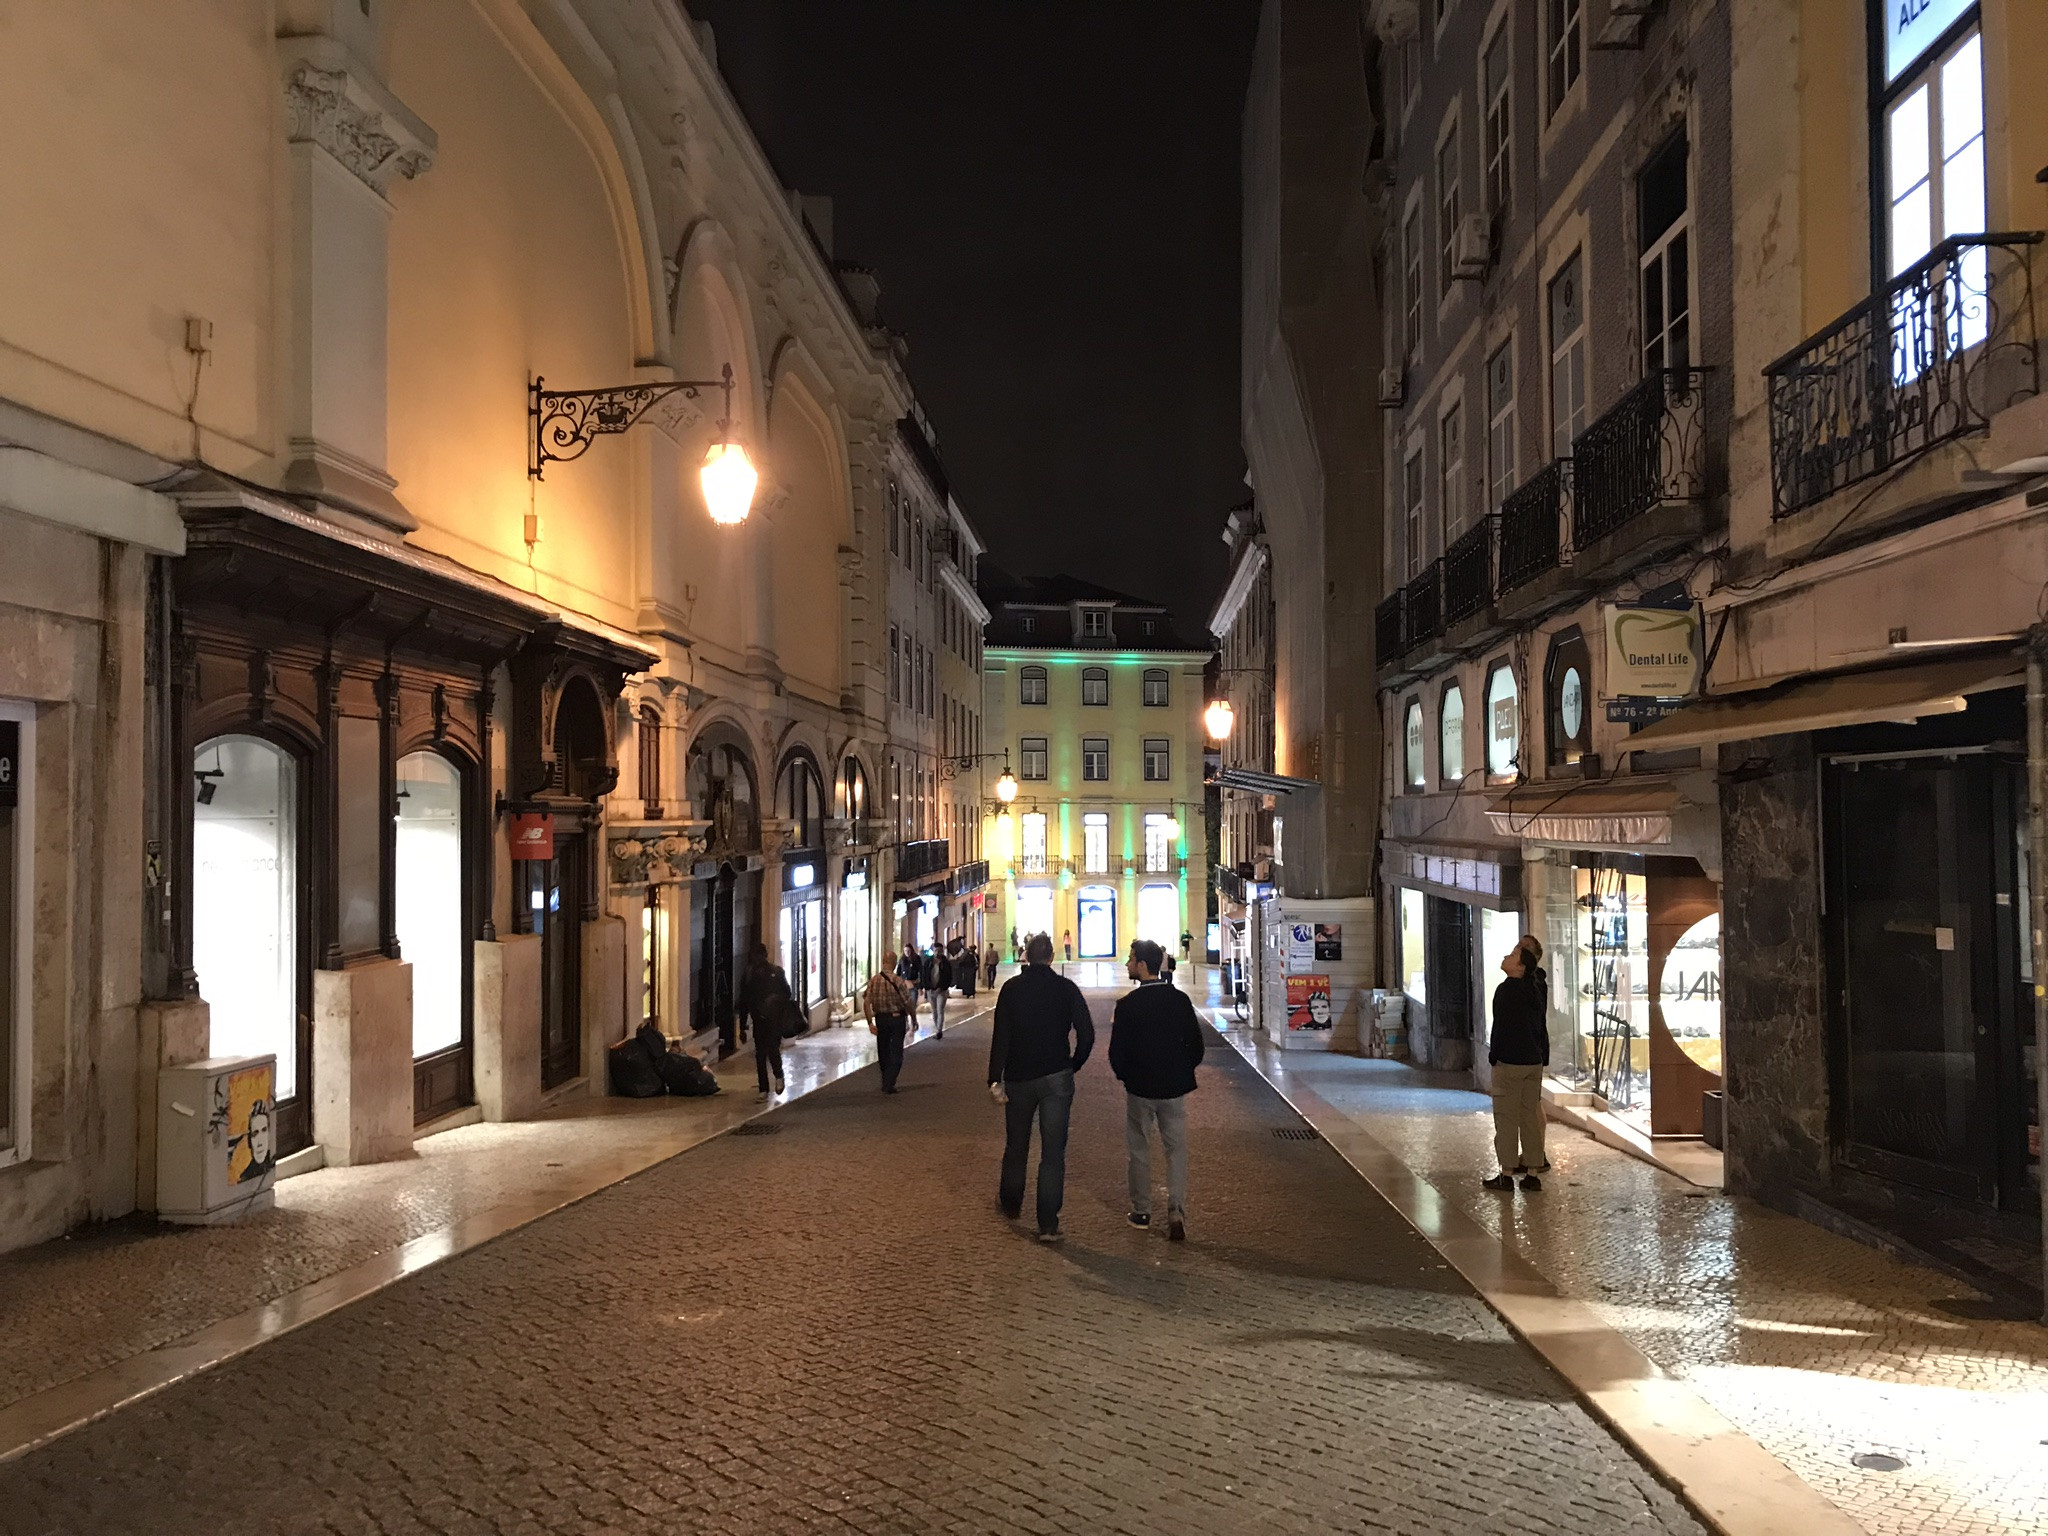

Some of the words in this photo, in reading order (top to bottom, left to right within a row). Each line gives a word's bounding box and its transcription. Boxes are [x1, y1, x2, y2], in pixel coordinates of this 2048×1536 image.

[1629, 653, 1665, 666] Dental
[1668, 653, 1689, 665] Life
[1624, 707, 1636, 717] 76
[1287, 978, 1306, 987] VEM
